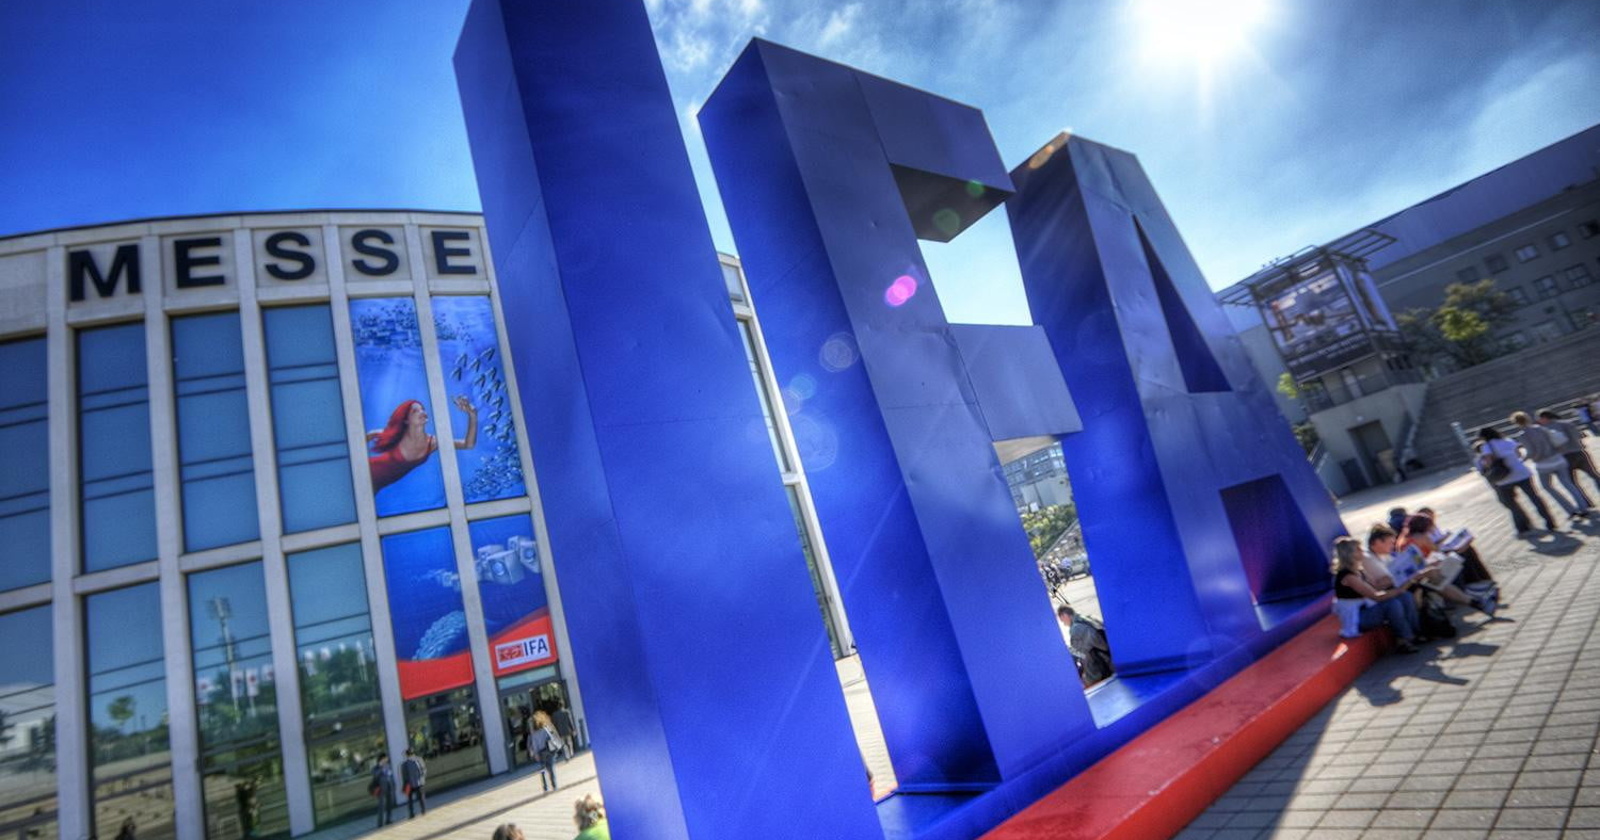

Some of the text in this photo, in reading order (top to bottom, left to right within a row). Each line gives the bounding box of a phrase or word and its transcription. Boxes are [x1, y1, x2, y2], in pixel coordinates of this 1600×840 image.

[69, 229, 478, 302] MESSE
[454, 0, 1348, 840] IFA
[524, 637, 548, 657] IFA
